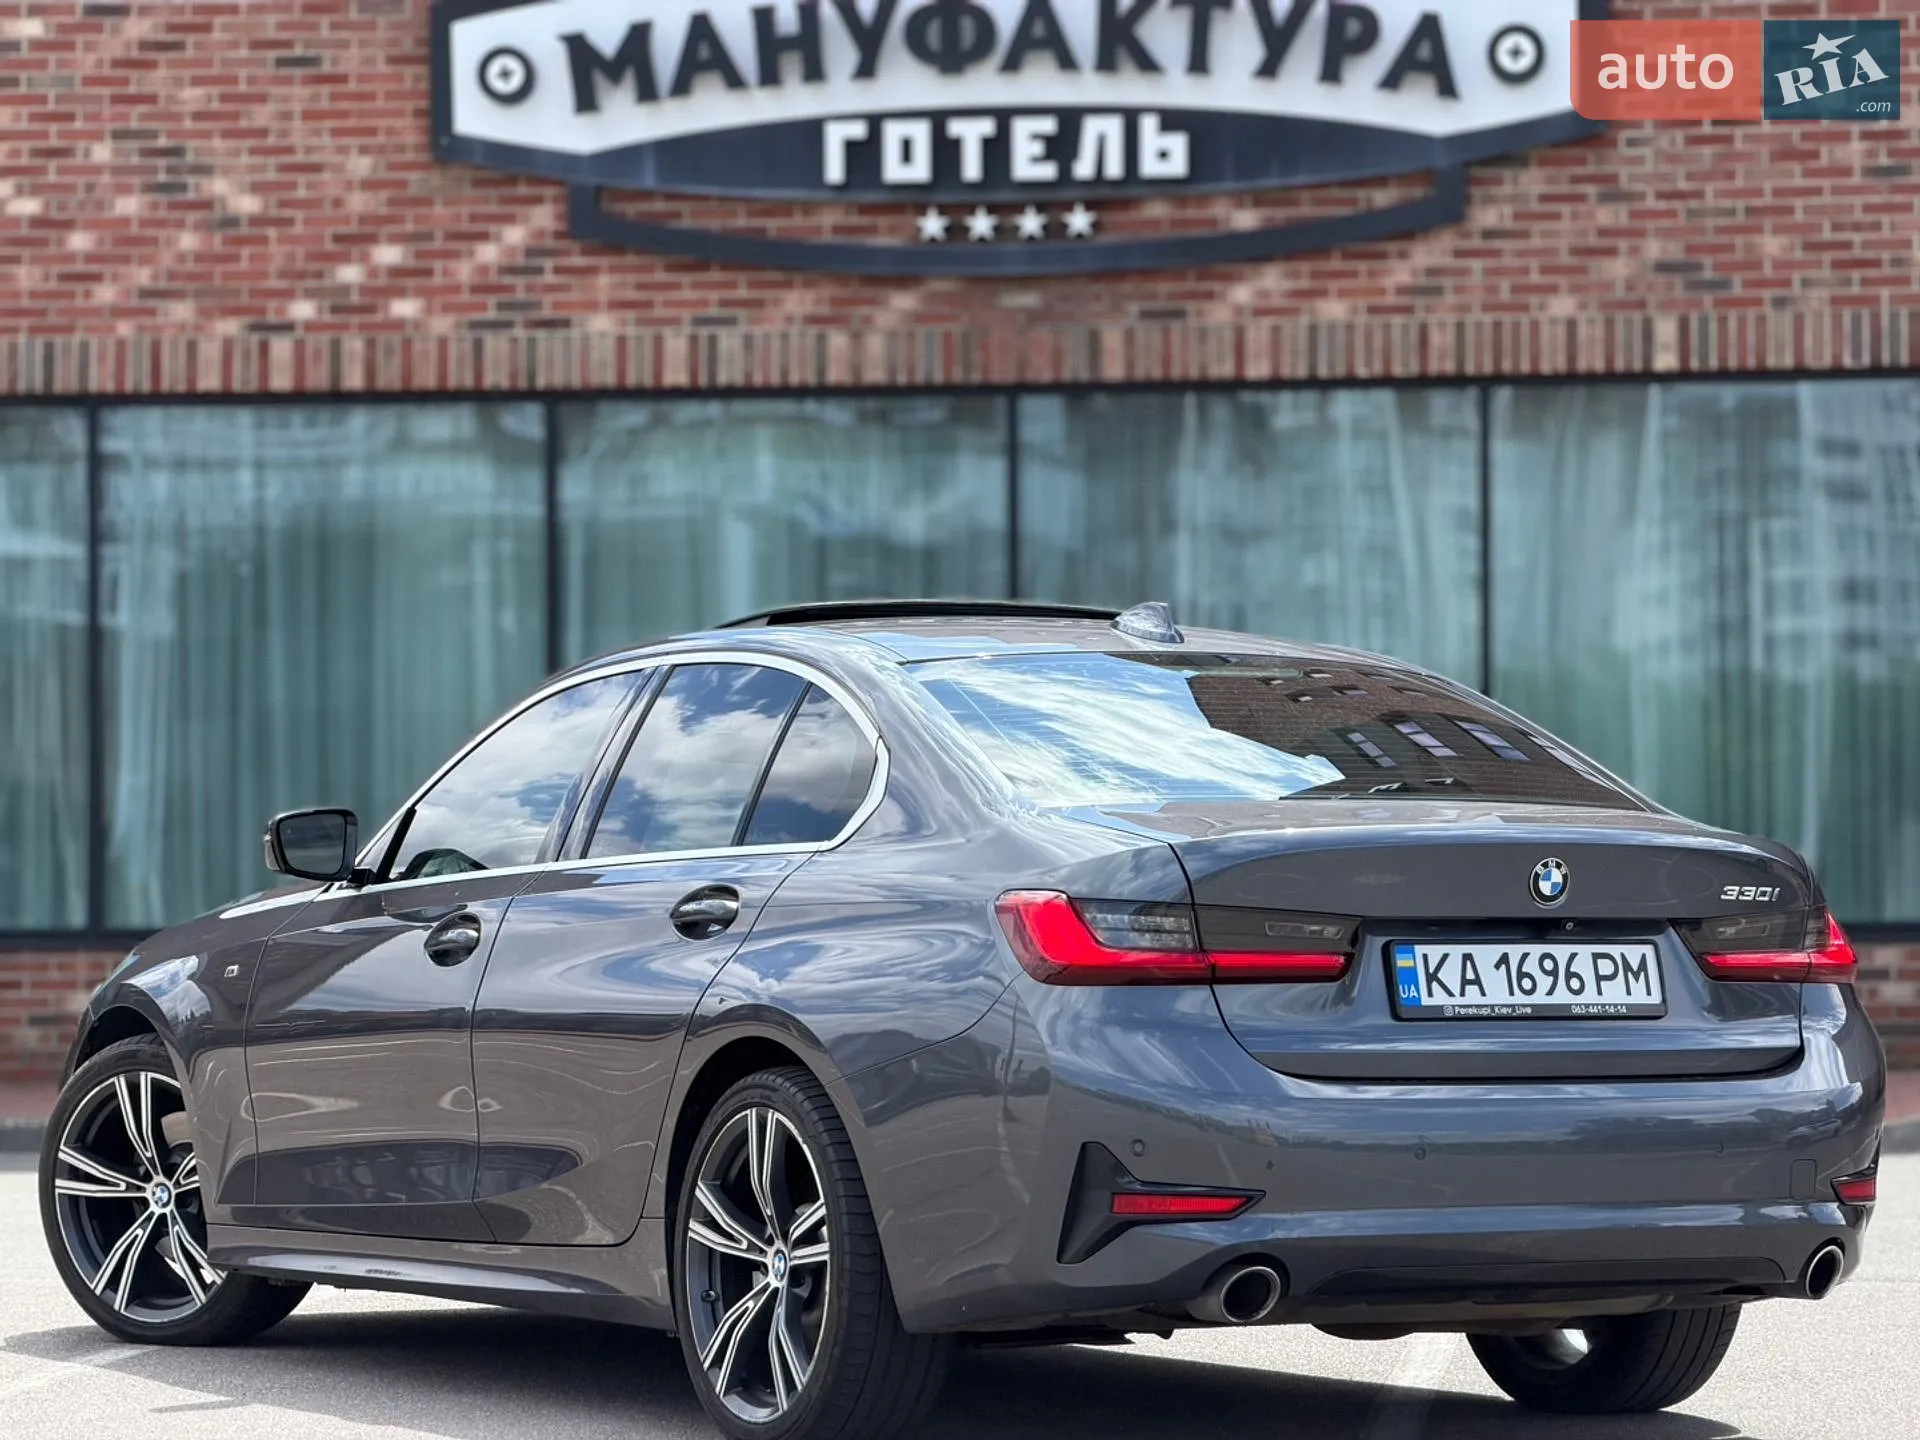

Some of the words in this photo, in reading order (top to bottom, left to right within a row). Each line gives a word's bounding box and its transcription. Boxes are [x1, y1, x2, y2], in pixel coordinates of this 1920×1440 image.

[557, 0, 1461, 114] МАНУФАКТУРА
[822, 112, 1190, 186] ГОТЕЛЬ
[1399, 984, 1419, 998] UA
